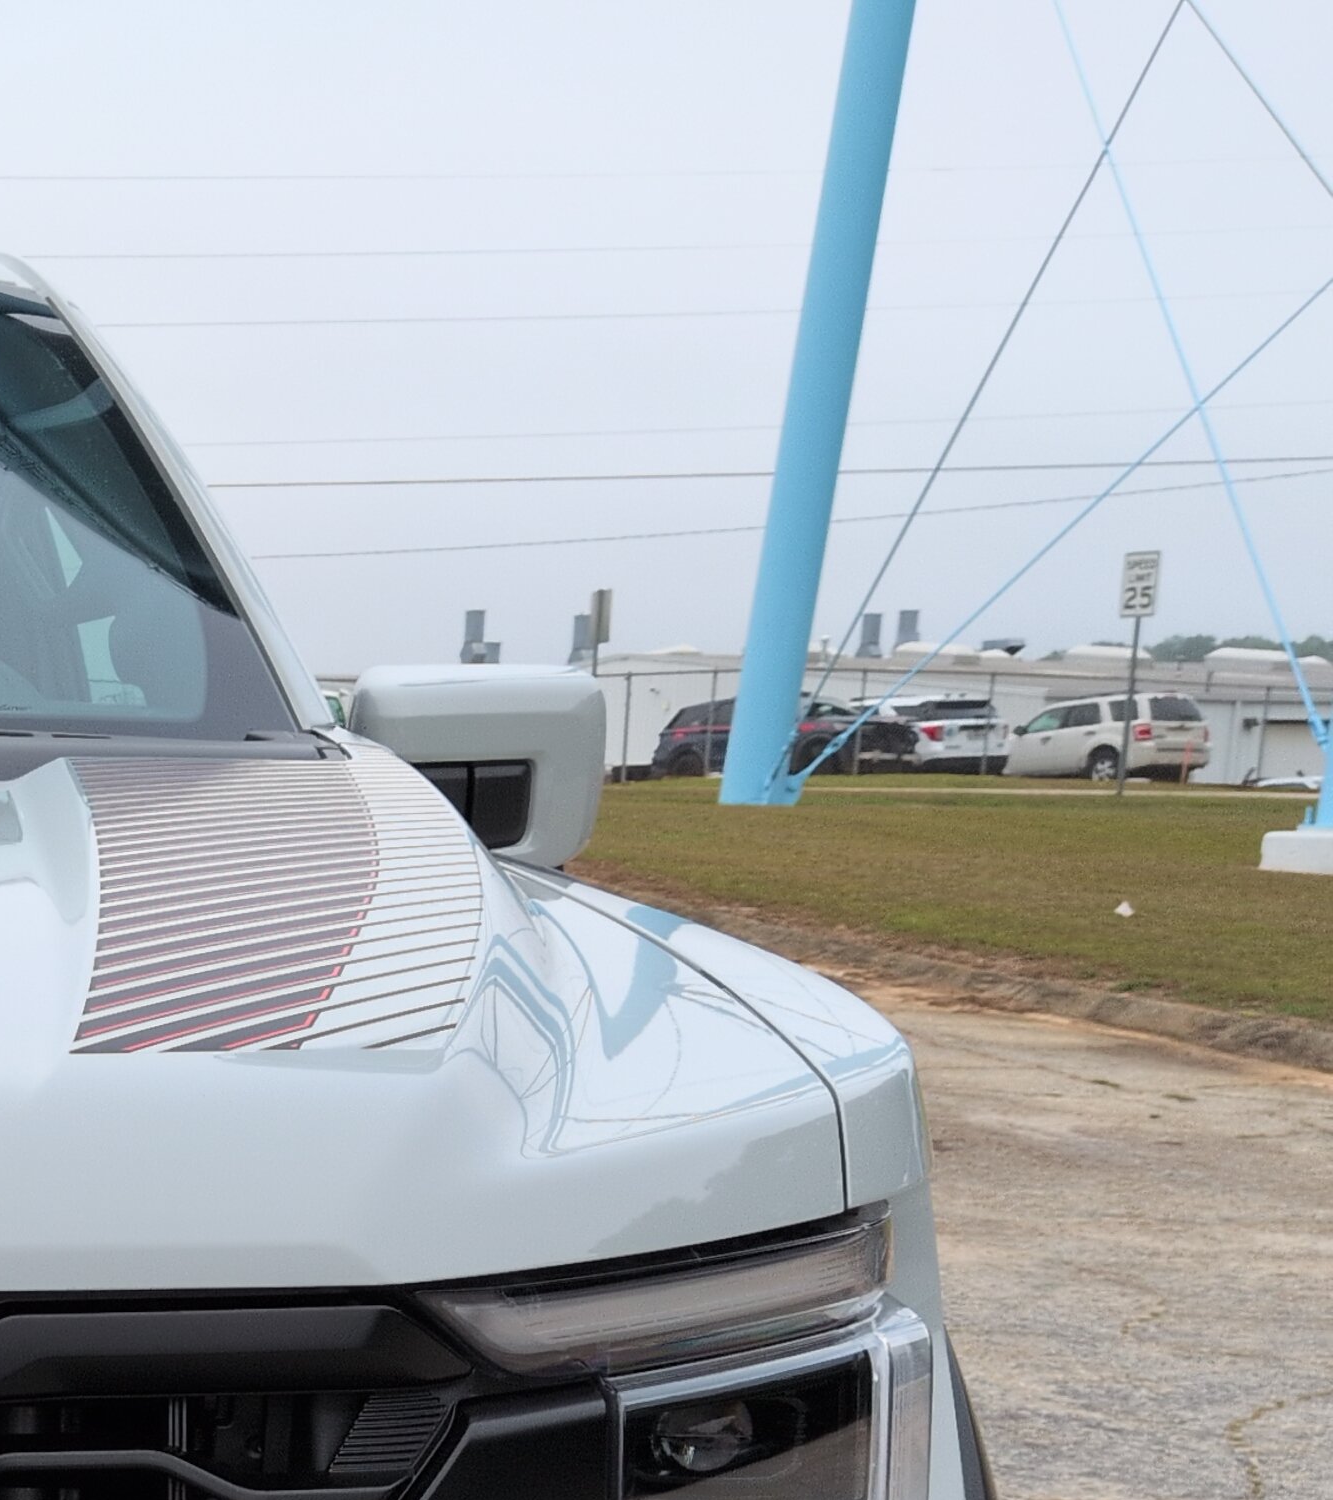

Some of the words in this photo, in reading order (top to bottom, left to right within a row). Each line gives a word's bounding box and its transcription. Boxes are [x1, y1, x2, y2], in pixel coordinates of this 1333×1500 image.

[1126, 558, 1158, 570] SPEED
[1128, 571, 1152, 583] LIMIT
[1123, 585, 1154, 609] 25
